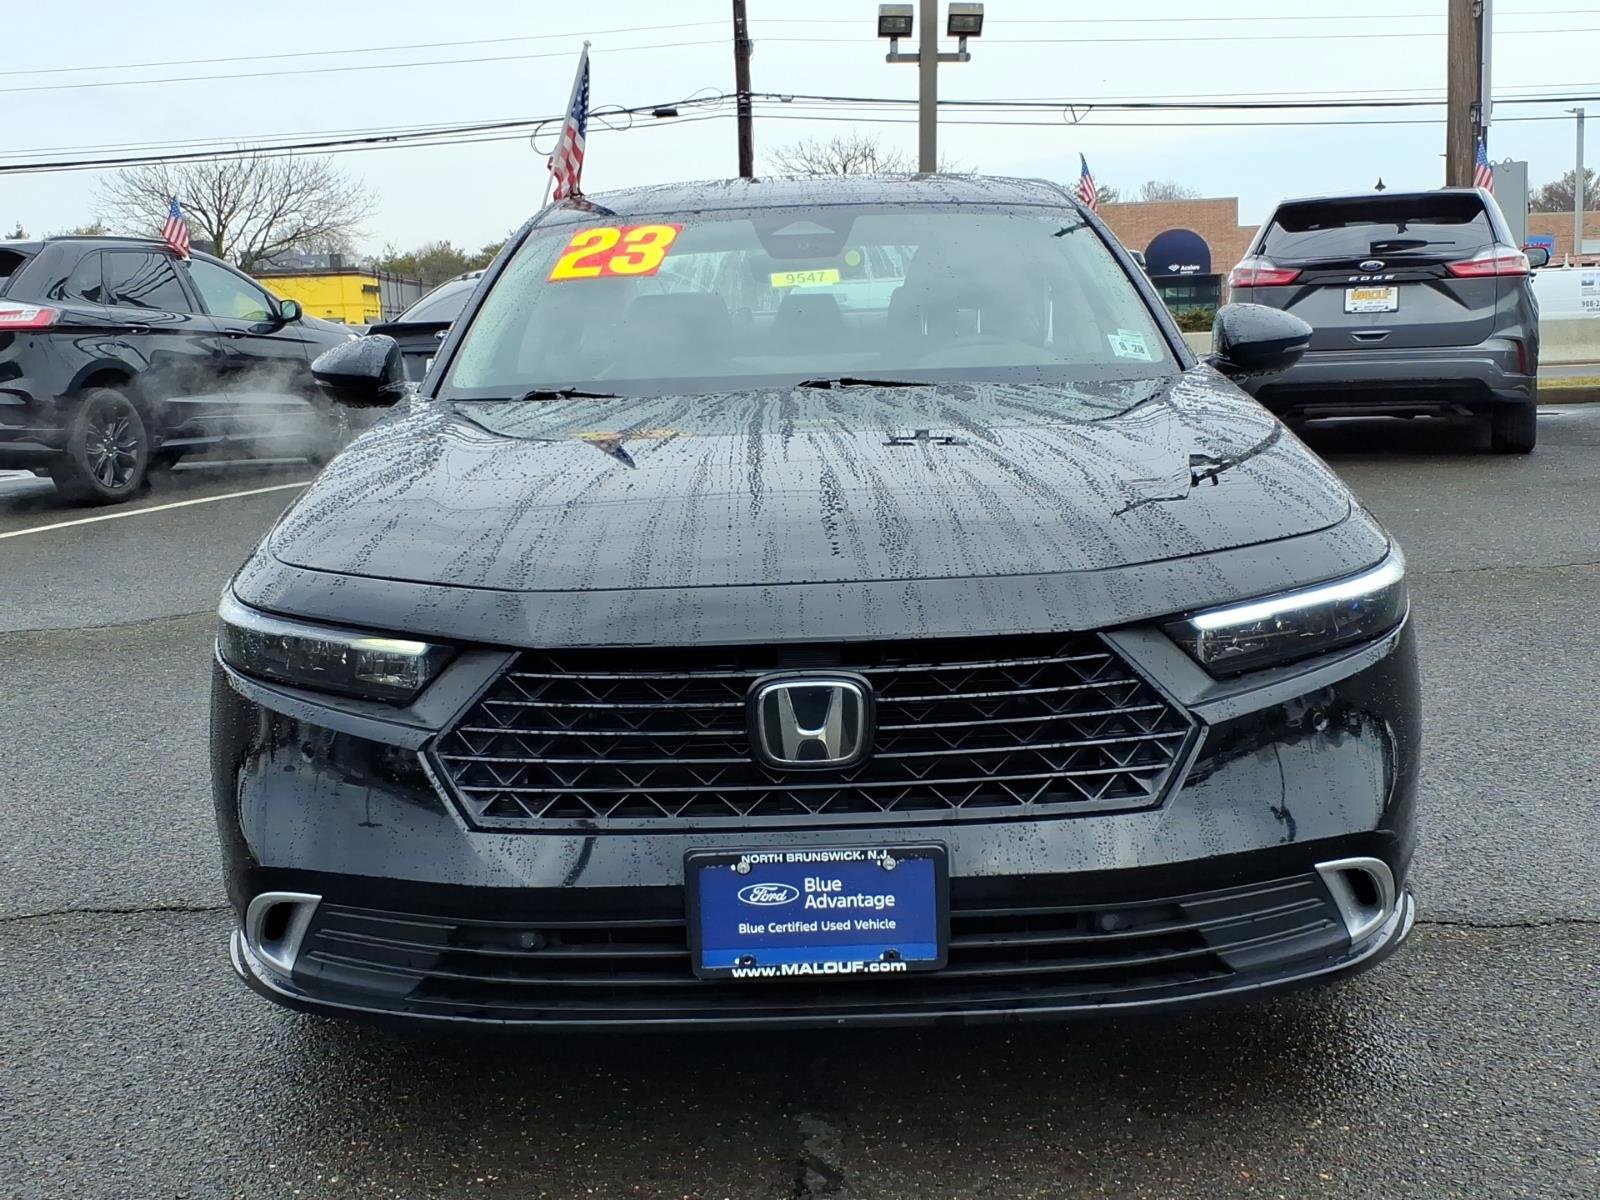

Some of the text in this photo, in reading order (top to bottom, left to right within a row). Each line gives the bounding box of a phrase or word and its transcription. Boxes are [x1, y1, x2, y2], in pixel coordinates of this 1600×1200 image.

[550, 225, 676, 279] 23
[785, 272, 824, 284] 9547
[741, 853, 783, 864] NORTH
[786, 851, 865, 863] BRUNSWICK,
[804, 877, 842, 892] Blue
[804, 893, 896, 910] Advantage
[738, 918, 897, 934] Blue Certified Used Vehicle
[732, 960, 907, 978] www.MALOUF.com
